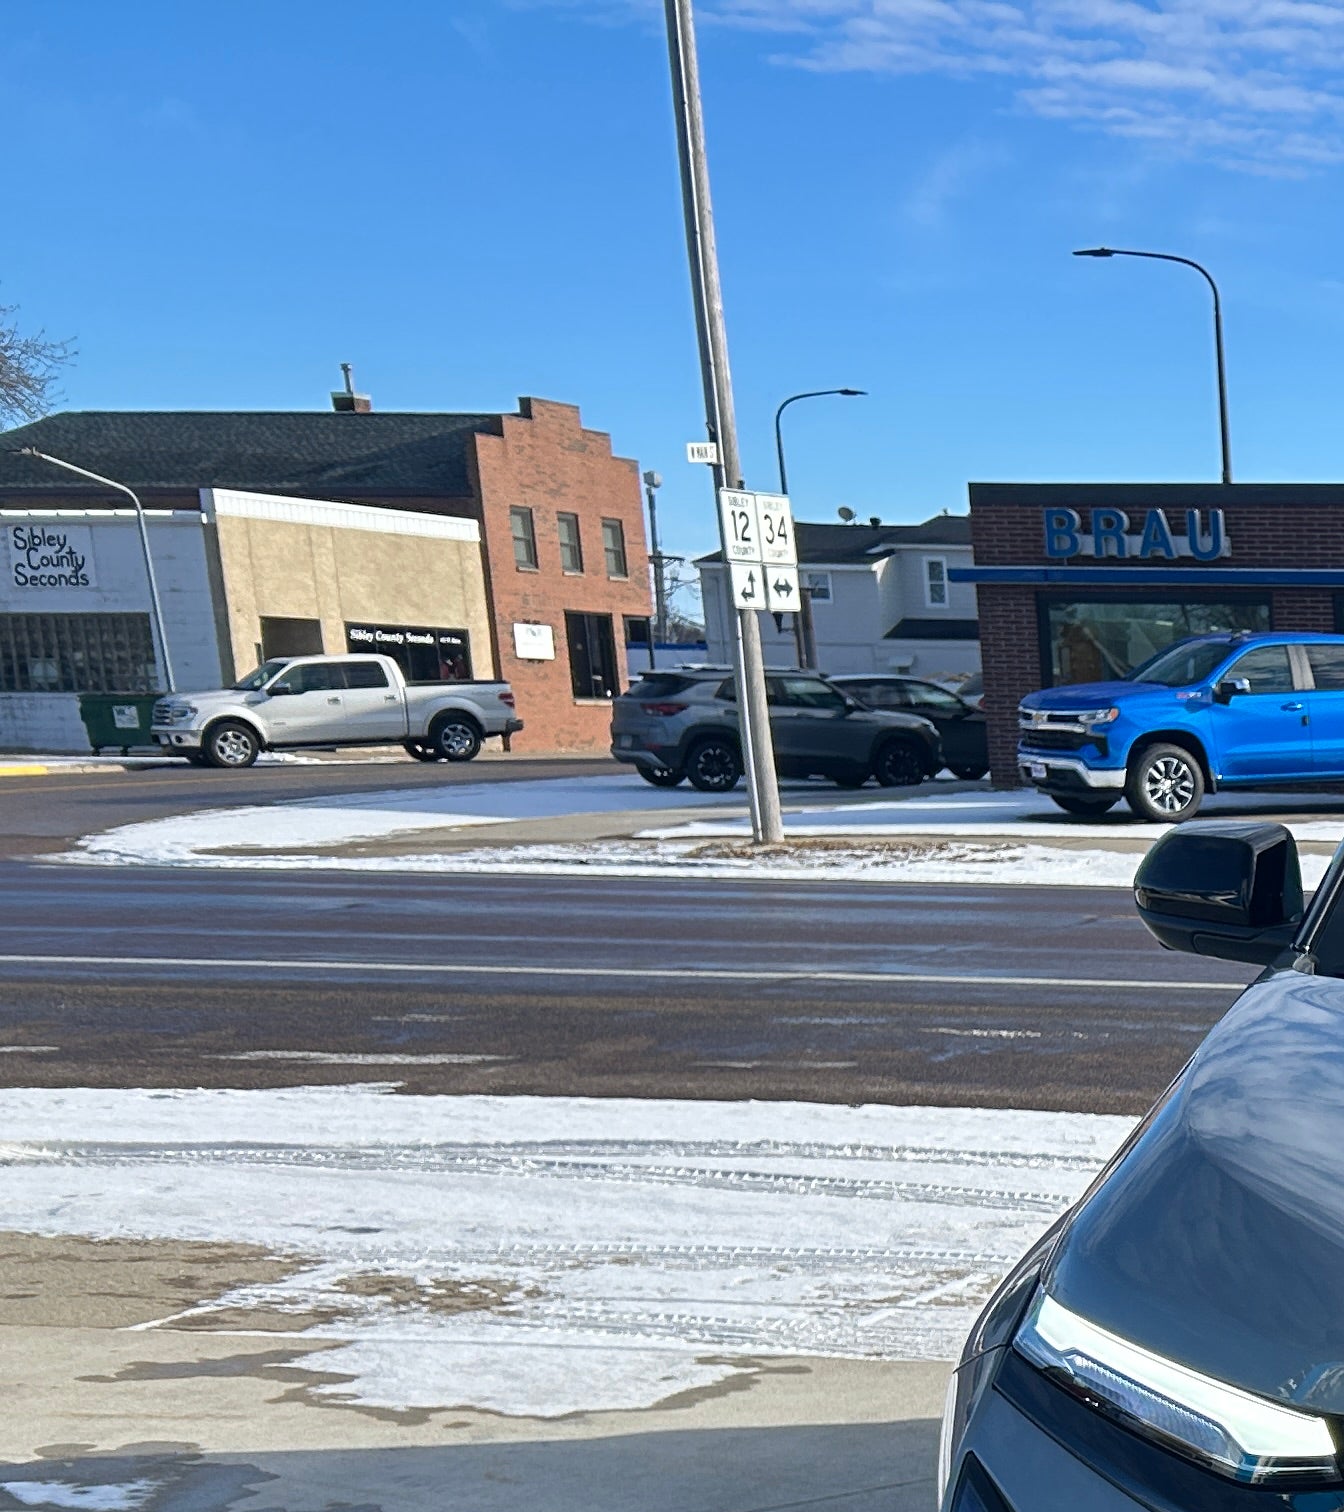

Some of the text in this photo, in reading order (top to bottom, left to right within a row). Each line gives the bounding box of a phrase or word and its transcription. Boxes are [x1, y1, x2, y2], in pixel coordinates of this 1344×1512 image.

[728, 496, 750, 507] SIBLEY
[731, 510, 751, 542] 12
[764, 514, 787, 545] 34
[1044, 507, 1226, 561] BRAU
[13, 527, 67, 554] Sibley
[732, 545, 755, 556] COUNTY
[26, 546, 86, 573] County
[15, 563, 90, 587] Seconds
